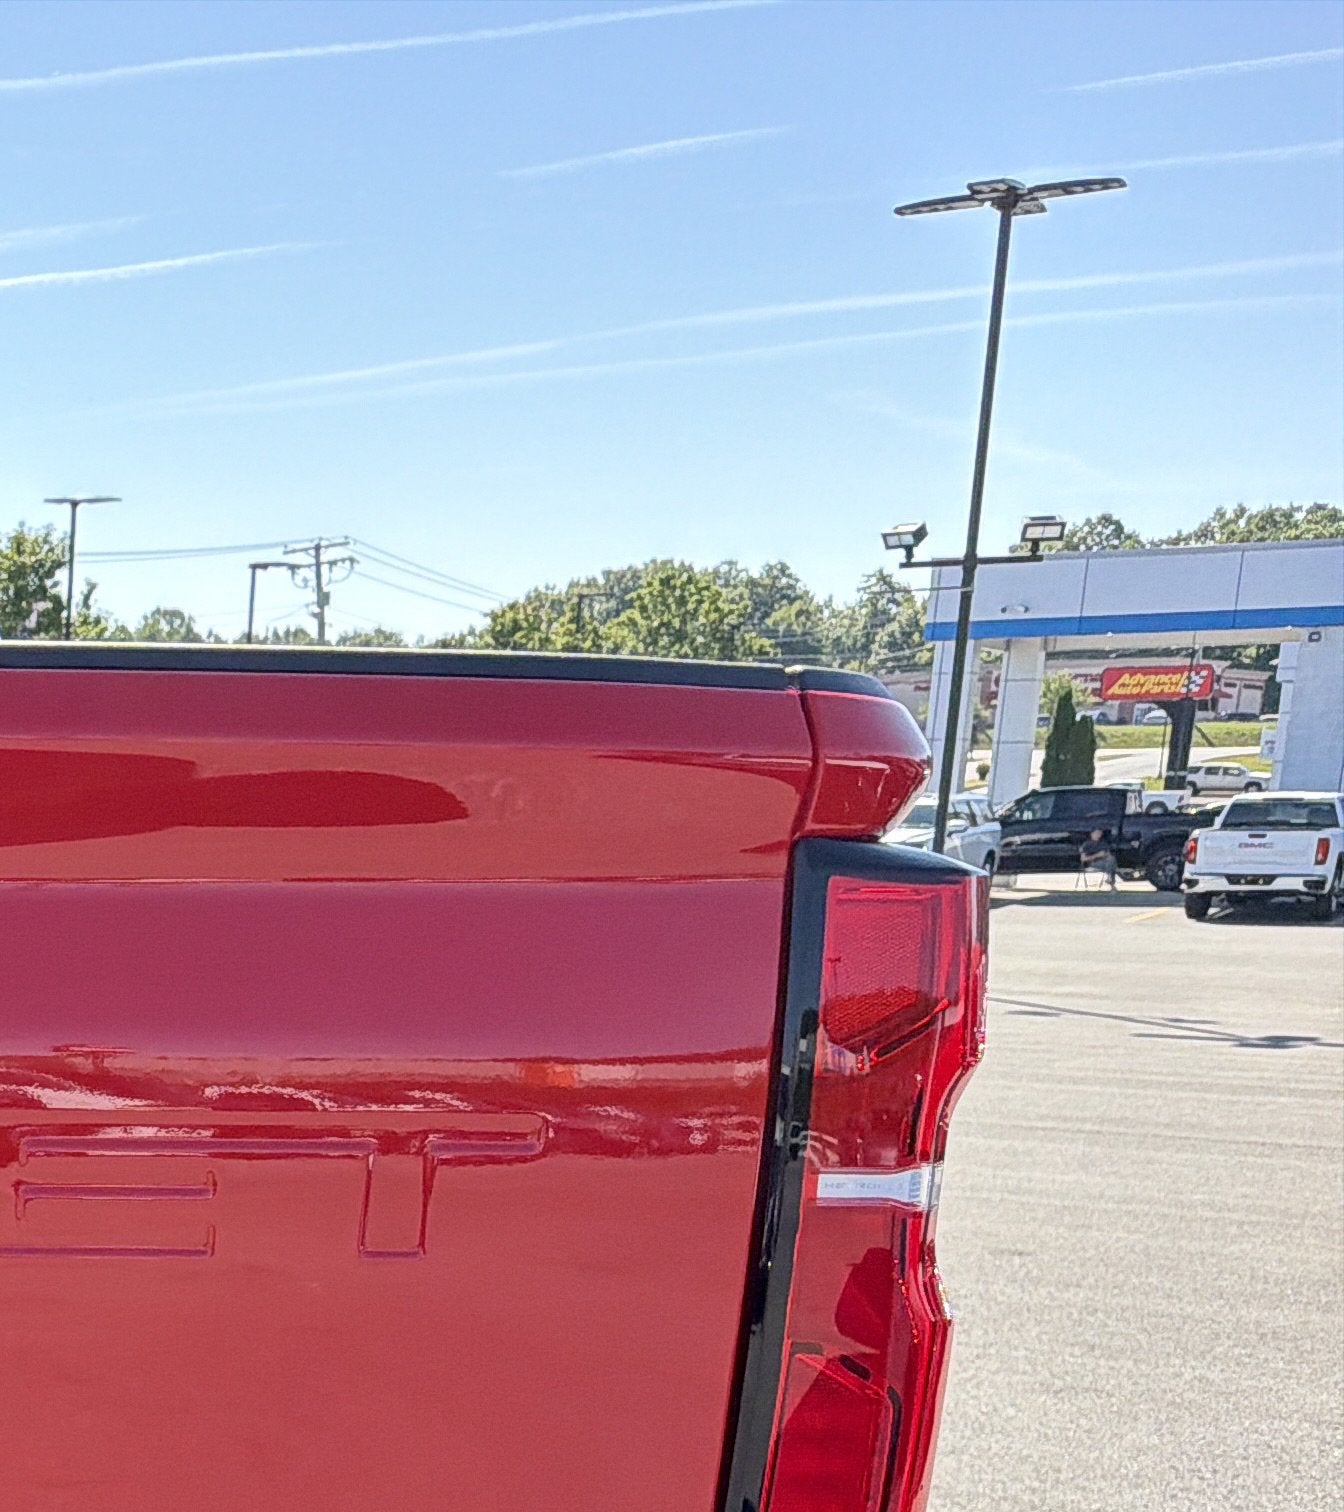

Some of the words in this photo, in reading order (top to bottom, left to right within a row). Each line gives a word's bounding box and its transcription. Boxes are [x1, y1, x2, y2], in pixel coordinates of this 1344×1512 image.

[1119, 671, 1183, 685] Advance
[1107, 681, 1141, 695] Auto
[1140, 682, 1182, 695] Parts
